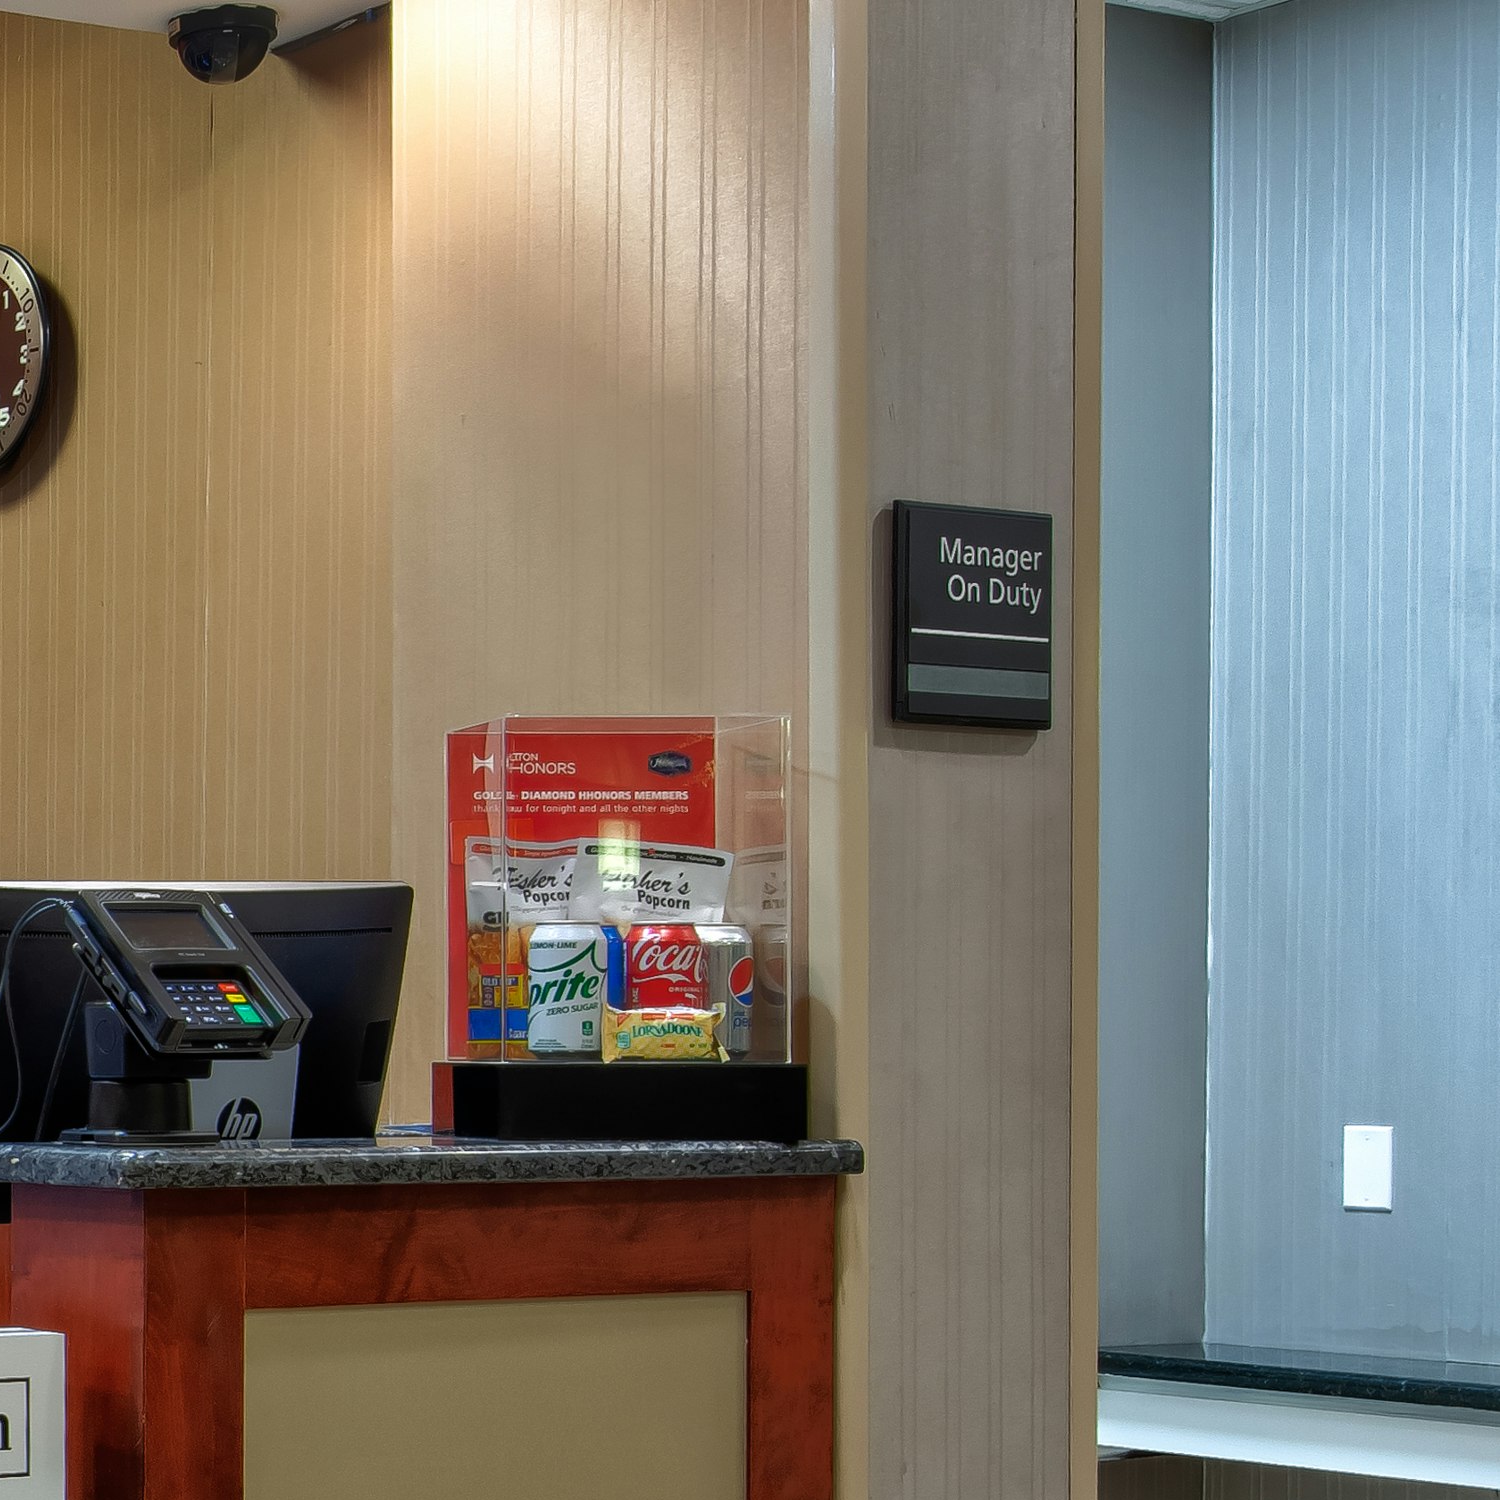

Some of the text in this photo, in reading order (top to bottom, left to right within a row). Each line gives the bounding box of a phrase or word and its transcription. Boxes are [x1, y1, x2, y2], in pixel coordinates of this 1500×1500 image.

[2, 290, 9, 309] 1
[19, 287, 34, 313] 10
[15, 311, 26, 332] 2
[12, 378, 25, 397] 4
[0, 407, 10, 427] 5
[939, 536, 1042, 577] Manager
[947, 574, 1042, 615] On Duty
[521, 791, 576, 800] DIAMOND
[578, 791, 631, 800] HHONORS
[634, 791, 689, 800] MEMBERS
[526, 804, 539, 812] for
[579, 804, 597, 813] and
[614, 804, 629, 813] the
[523, 889, 570, 906] Popcor
[637, 889, 691, 910] Popcorn
[528, 968, 600, 1007] prite
[546, 1002, 599, 1016] ZERO SUGAR
[221, 1096, 258, 1140] hp
